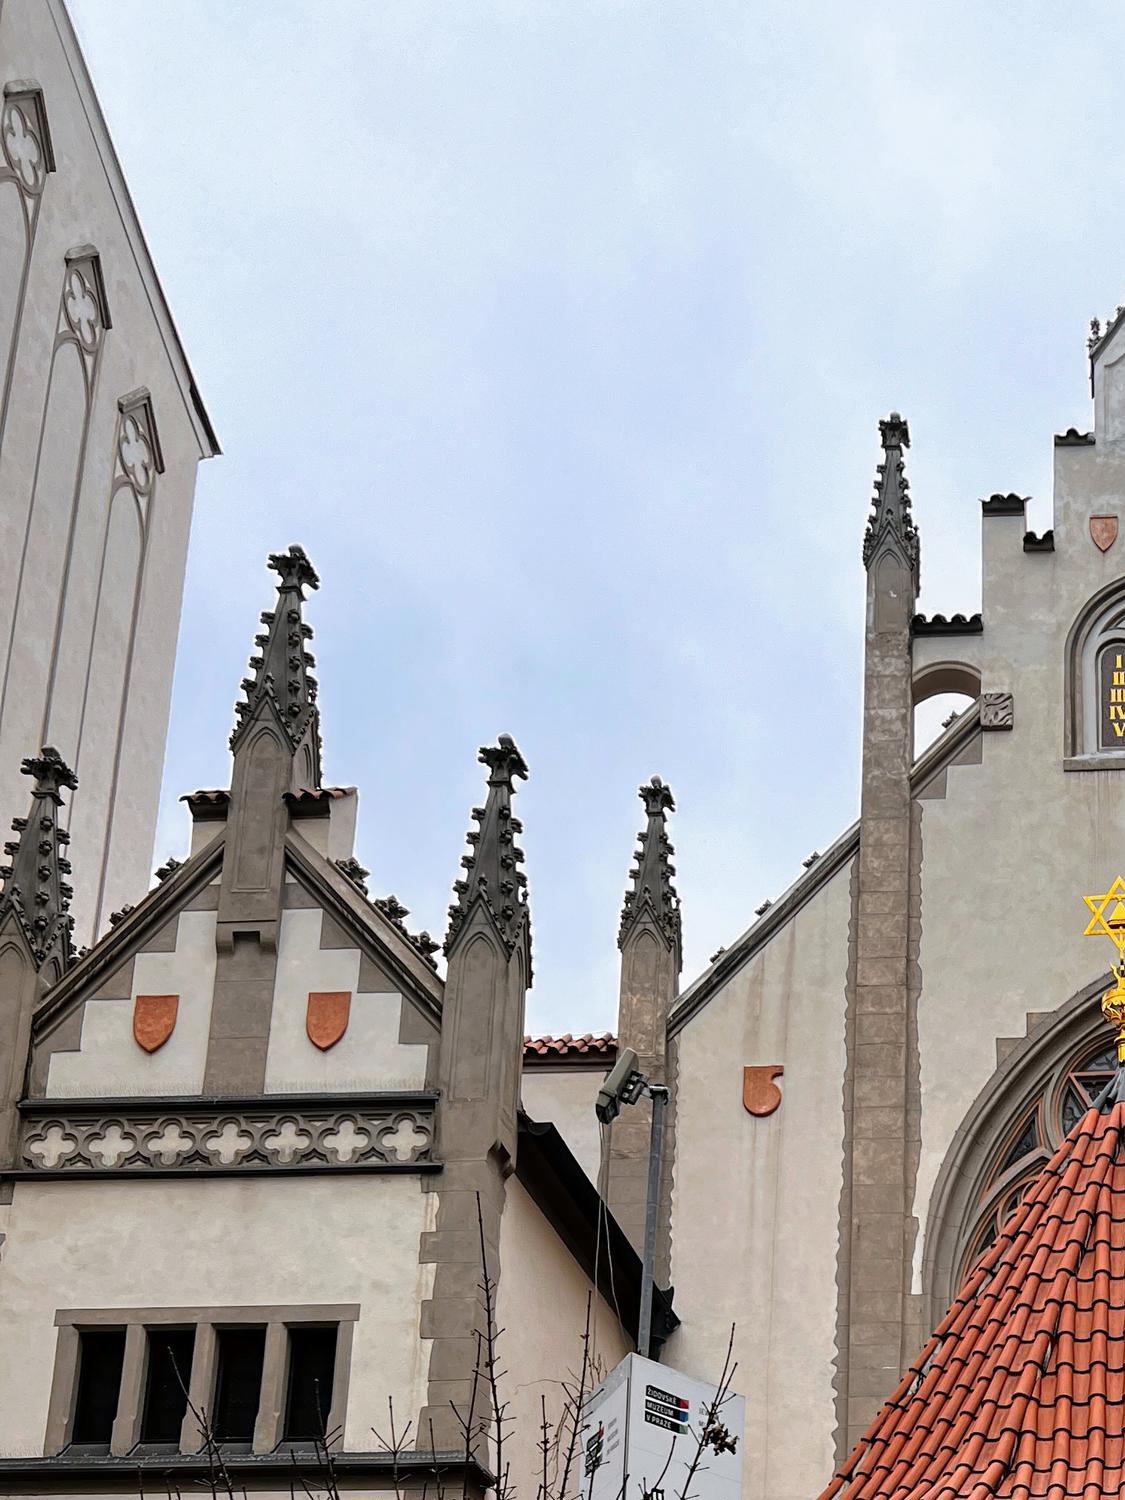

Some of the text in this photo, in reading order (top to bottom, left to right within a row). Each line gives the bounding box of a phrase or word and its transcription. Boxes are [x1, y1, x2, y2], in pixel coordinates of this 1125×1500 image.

[1115, 654, 1122, 669] I
[1112, 671, 1125, 686] II
[647, 1386, 678, 1405] ŽIDOVSKÉ
[646, 1401, 674, 1416] MUZEUM
[646, 1413, 673, 1429] V PRAZE
